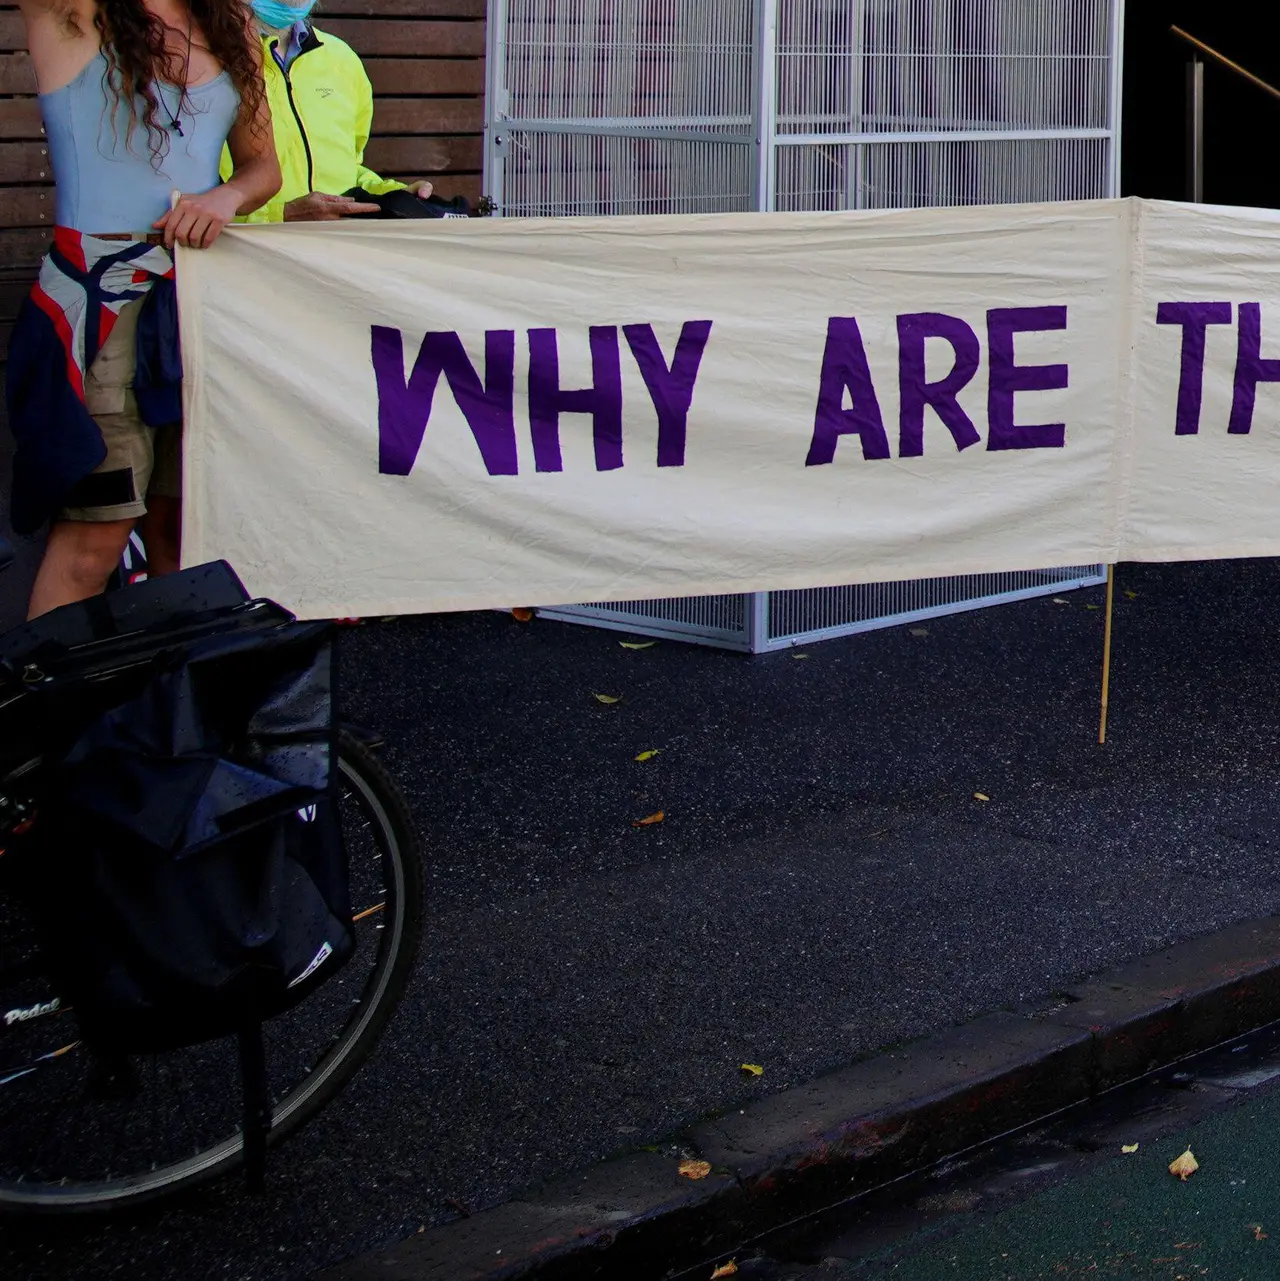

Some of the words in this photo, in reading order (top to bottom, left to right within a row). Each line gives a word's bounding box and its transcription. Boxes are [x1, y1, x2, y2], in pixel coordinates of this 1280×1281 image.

[370, 320, 713, 476] WHY
[805, 305, 1068, 467] ARE
[4, 997, 60, 1026] Pedal
